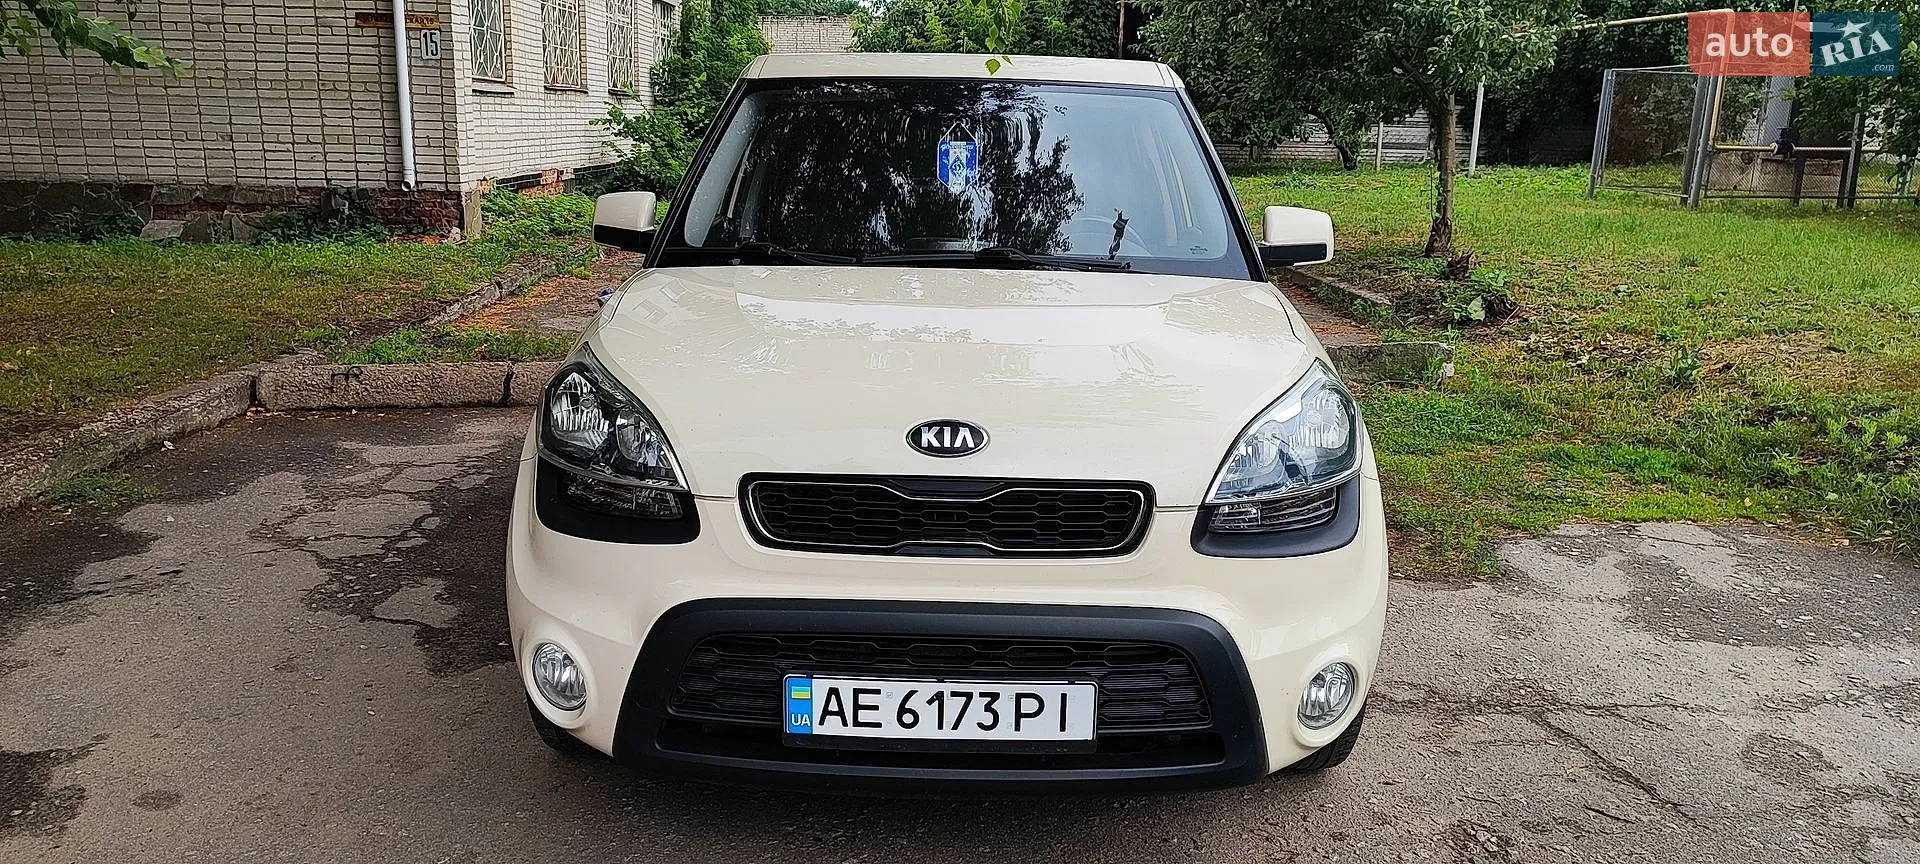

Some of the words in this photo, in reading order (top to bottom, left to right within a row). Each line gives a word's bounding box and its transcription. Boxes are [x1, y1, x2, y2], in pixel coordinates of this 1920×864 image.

[422, 31, 438, 57] 15
[920, 426, 975, 448] KIA
[791, 713, 811, 727] UA
[818, 686, 883, 729] AE
[896, 689, 1001, 732] 6173
[1013, 692, 1068, 733] PI
